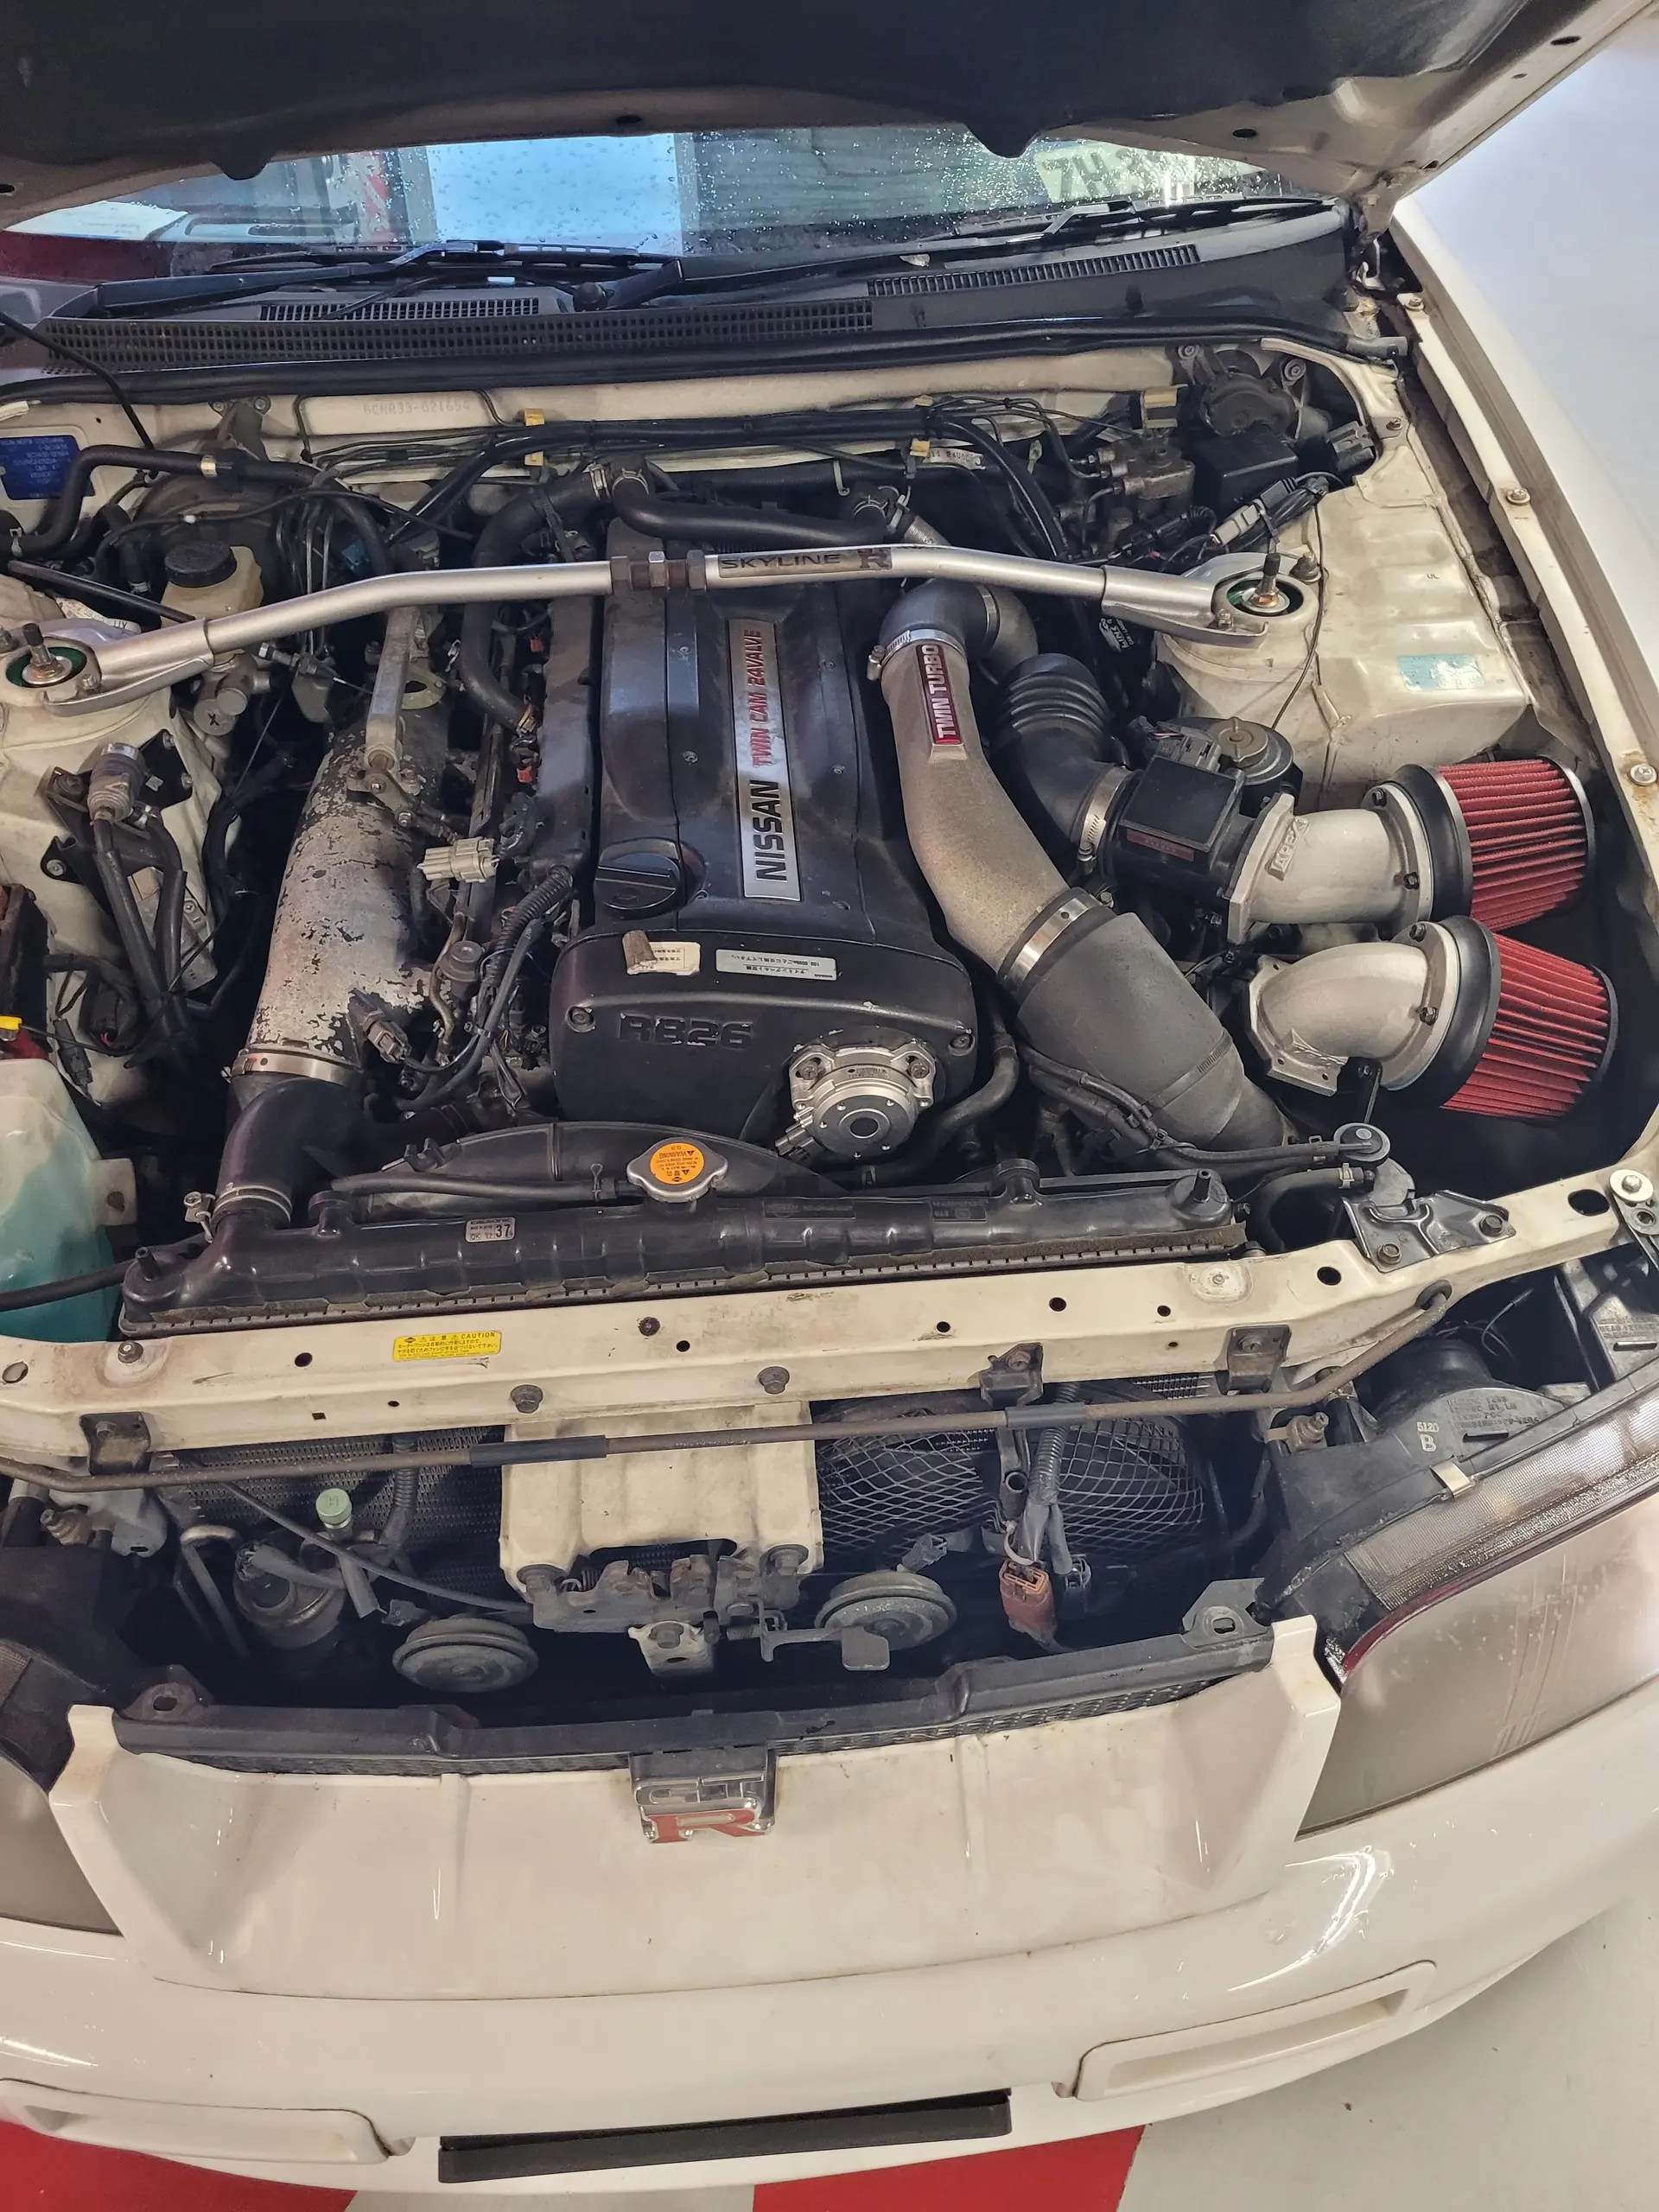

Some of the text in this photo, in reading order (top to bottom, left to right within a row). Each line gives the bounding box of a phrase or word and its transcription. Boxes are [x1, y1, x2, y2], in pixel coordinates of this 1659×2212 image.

[721, 554, 841, 569] SKYLINE
[921, 645, 957, 739] TWIN TURBO
[744, 629, 787, 882] NISSAN TWIN CAM 24VALVE
[619, 1010, 754, 1050] RB26
[1420, 1433, 1437, 1452] B
